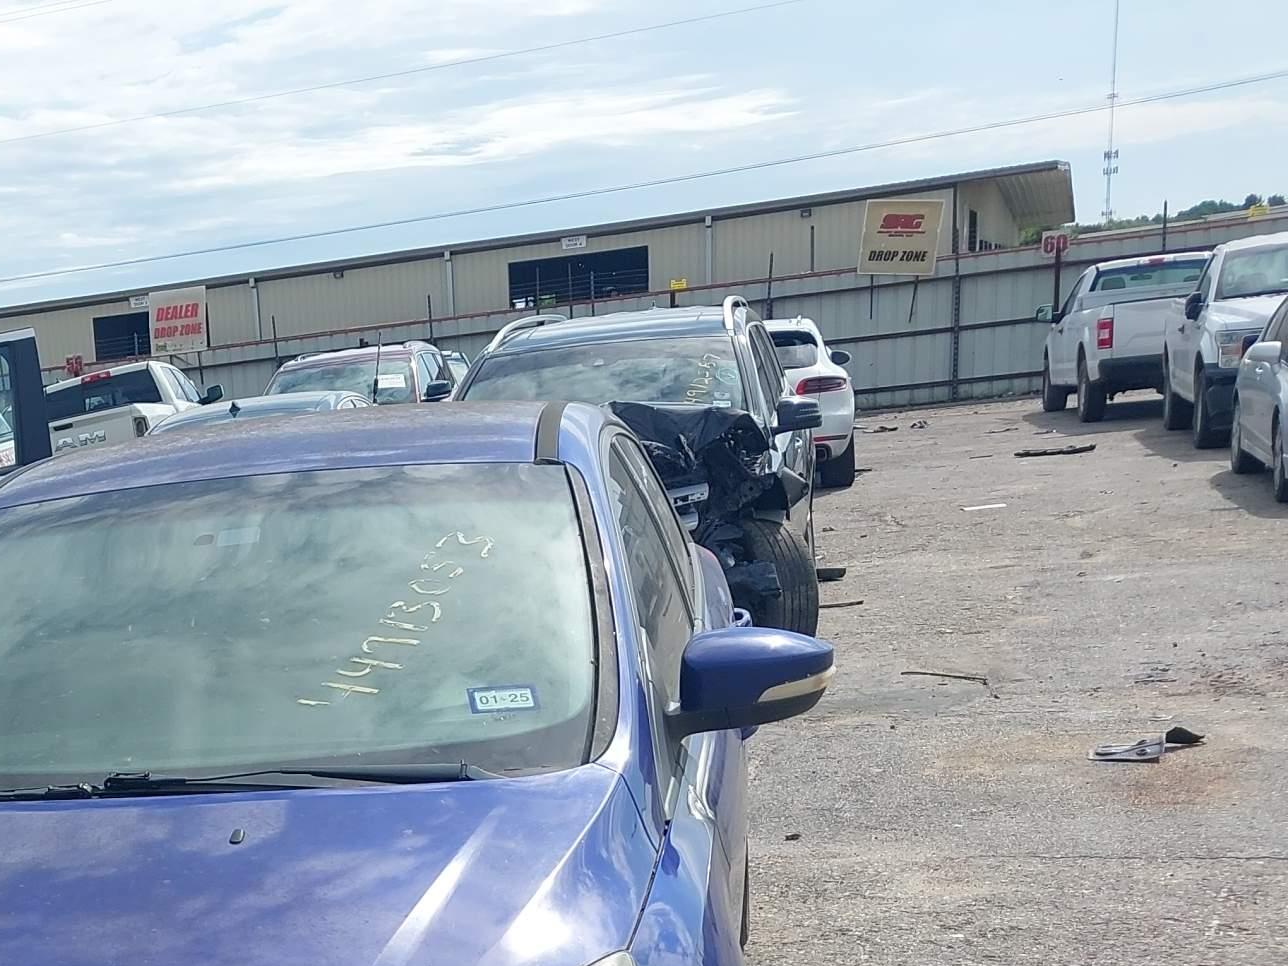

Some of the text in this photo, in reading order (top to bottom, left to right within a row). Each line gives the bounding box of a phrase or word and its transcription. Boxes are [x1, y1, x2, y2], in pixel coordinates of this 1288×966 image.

[1043, 234, 1069, 254] 60
[868, 250, 928, 262] DROP ZONE
[156, 303, 199, 322] DEALER
[154, 322, 202, 339] DROP ZONE
[479, 692, 530, 705] 01-25
